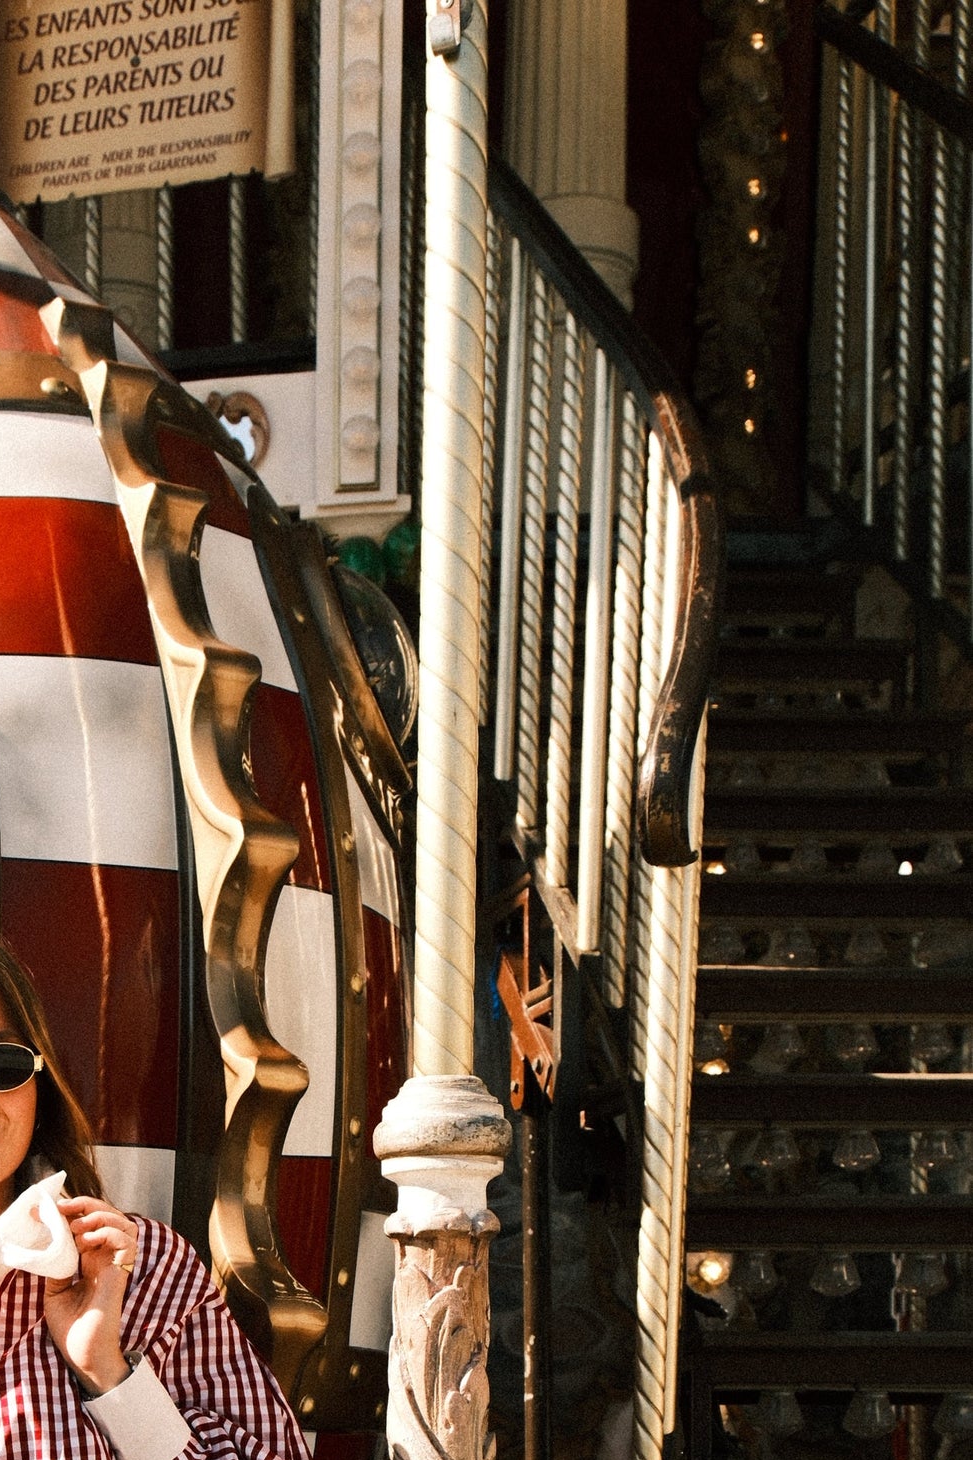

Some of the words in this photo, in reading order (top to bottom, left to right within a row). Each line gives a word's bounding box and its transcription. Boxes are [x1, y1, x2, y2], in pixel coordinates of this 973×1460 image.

[35, 0, 133, 38] ENFANTS
[17, 47, 45, 75] LA
[52, 11, 241, 69] RESPONSABILITÉ
[33, 79, 76, 107] DES
[82, 63, 183, 99] PARENTS
[189, 53, 225, 82] OU
[23, 114, 52, 141] DE
[59, 104, 129, 136] LEURS
[138, 87, 236, 125] TUTEURS
[42, 170, 91, 188] PARENTS
[94, 167, 111, 181] OR
[67, 154, 91, 169] ARE
[101, 148, 133, 164] NDER
